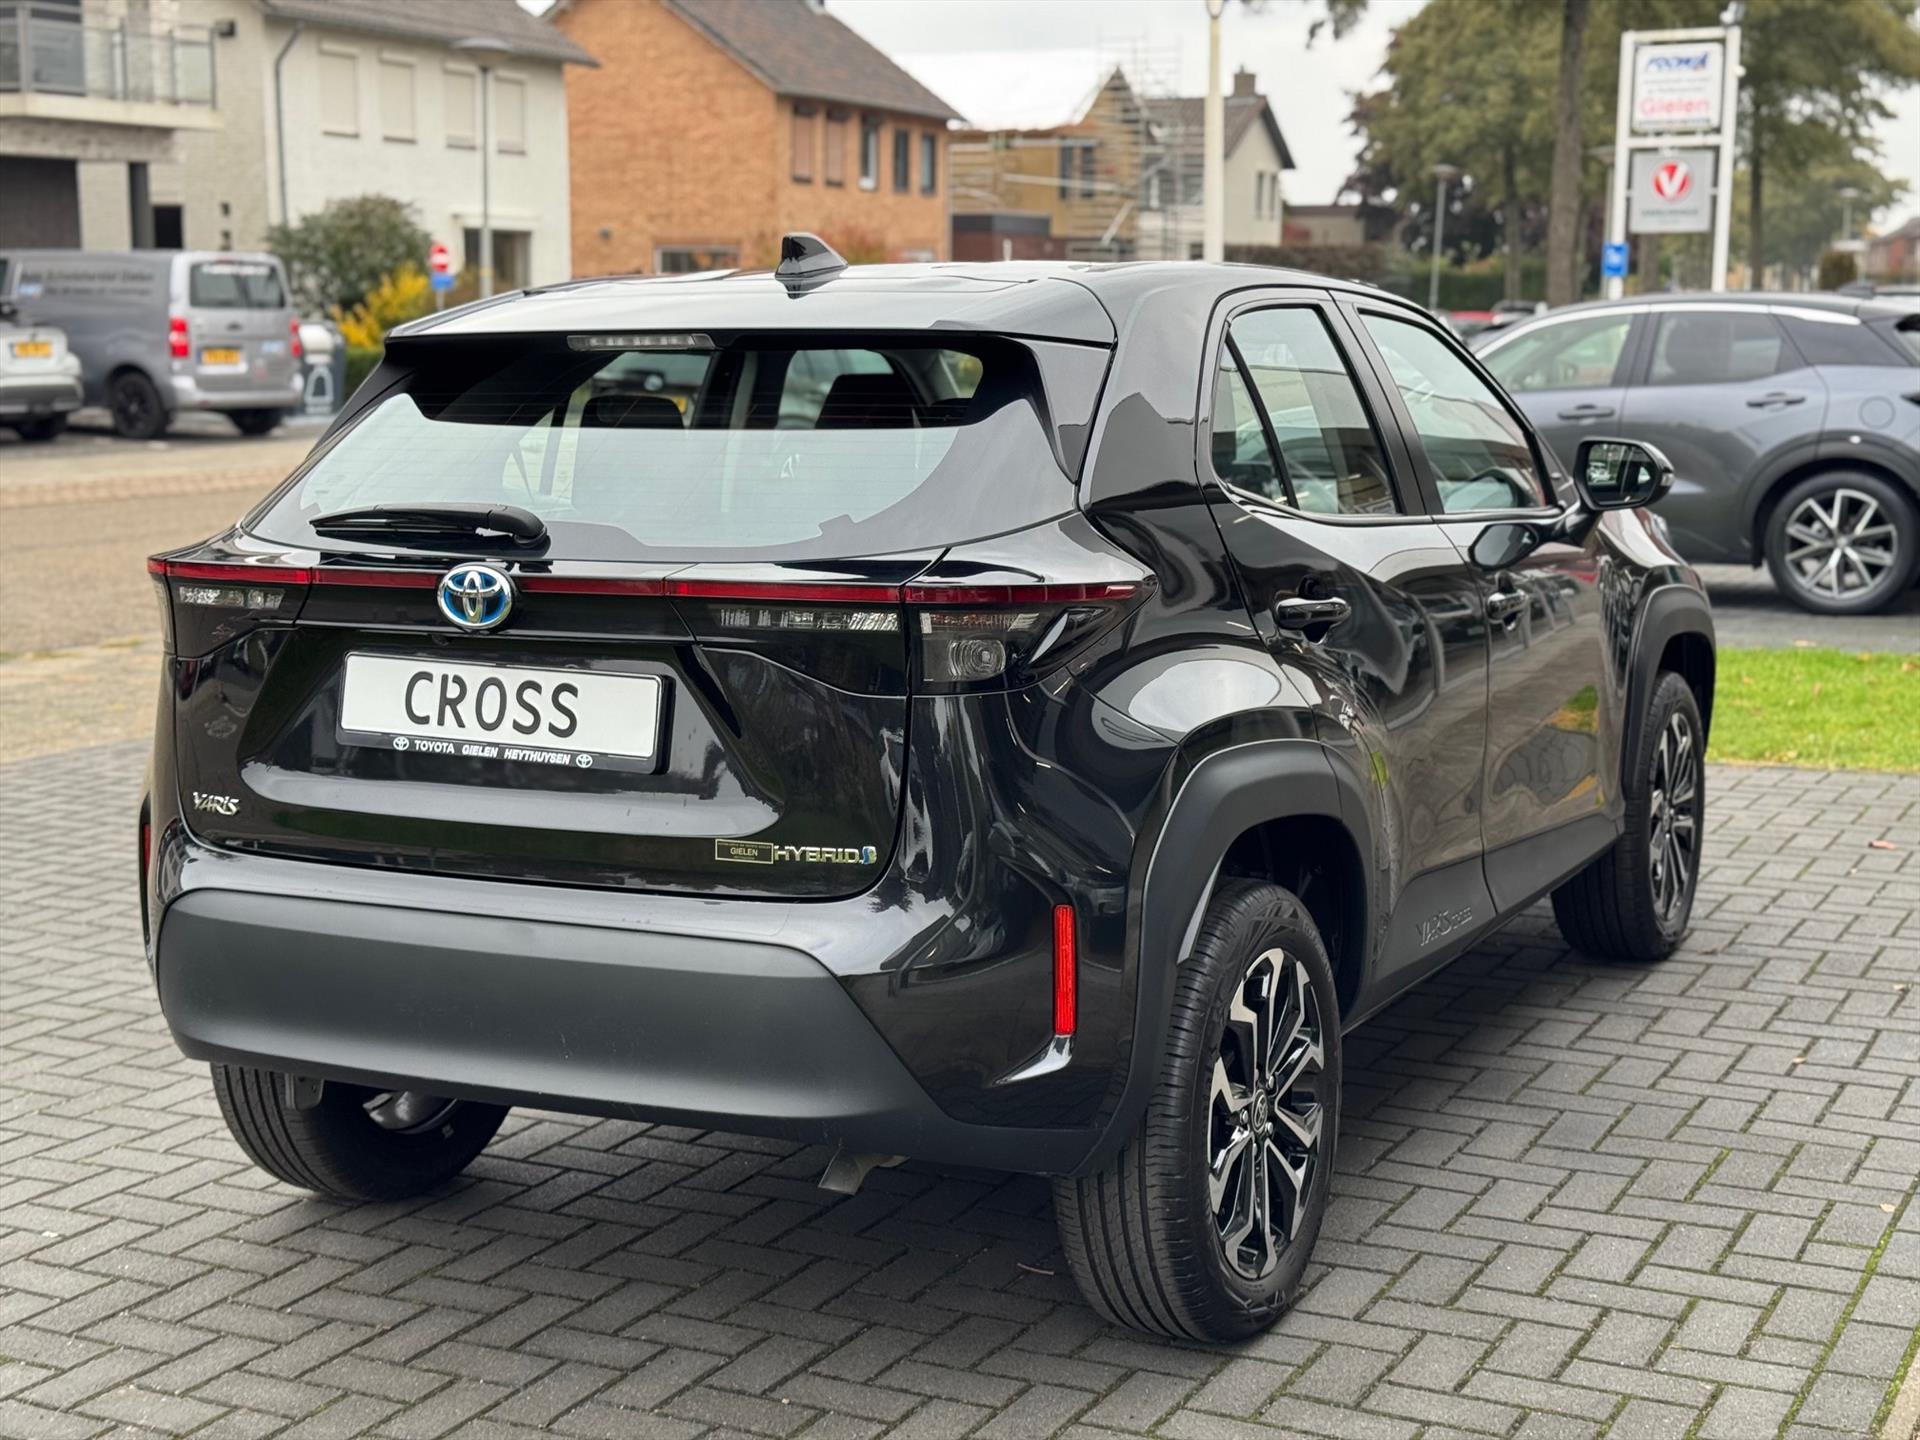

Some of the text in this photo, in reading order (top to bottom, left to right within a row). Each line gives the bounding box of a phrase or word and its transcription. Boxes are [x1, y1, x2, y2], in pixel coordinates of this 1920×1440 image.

[404, 671, 579, 738] CROSS
[414, 740, 571, 765] TOYOTA GIELEN HEYTHUYSEN
[192, 791, 240, 816] YARIS
[730, 847, 758, 857] GIELEN
[774, 846, 860, 864] HYBRID
